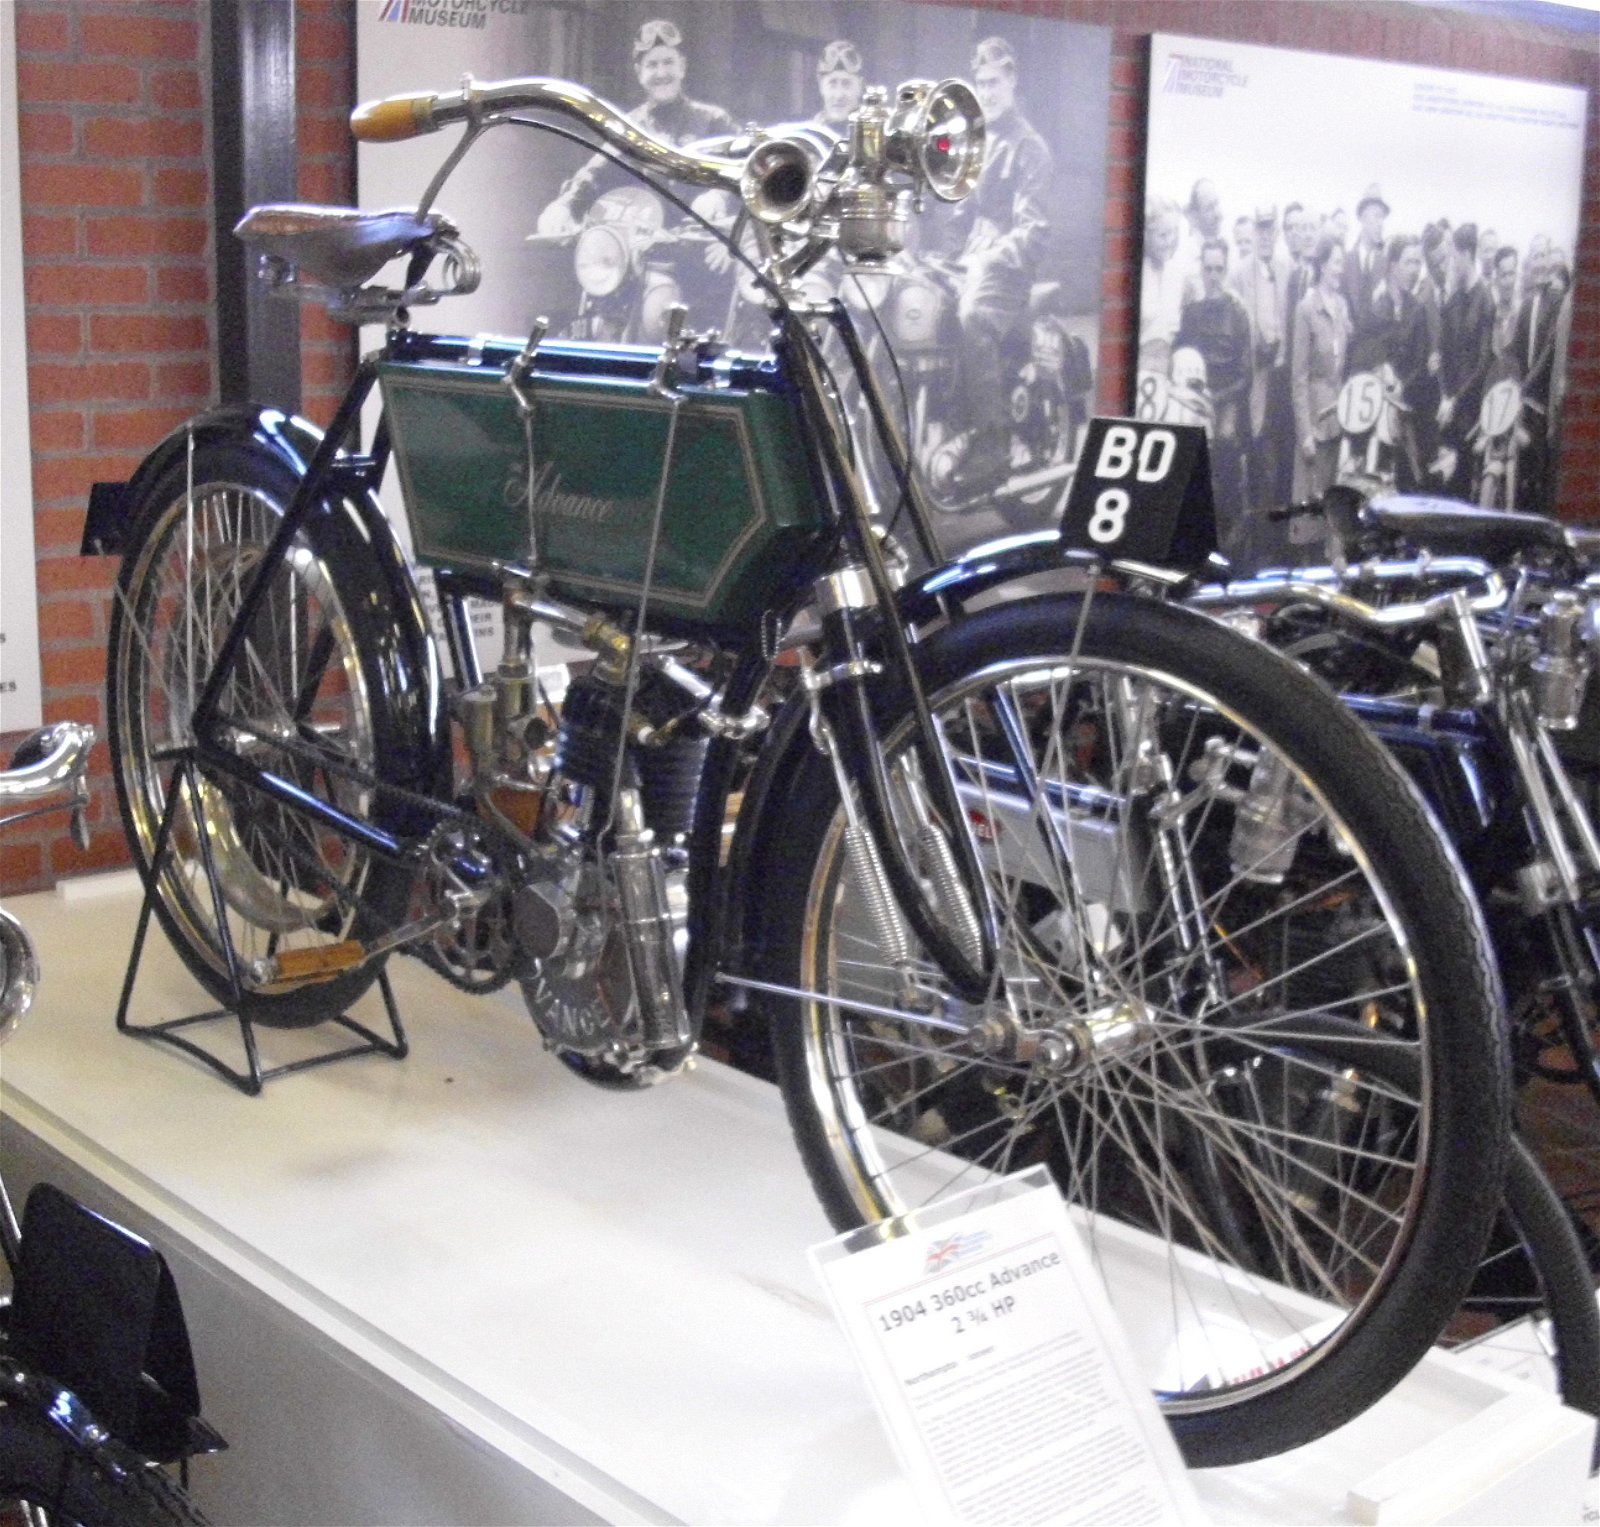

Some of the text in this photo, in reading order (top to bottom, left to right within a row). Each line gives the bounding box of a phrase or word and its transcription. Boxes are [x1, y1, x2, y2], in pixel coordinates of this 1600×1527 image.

[408, 9, 486, 29] MUSEUM
[1345, 381, 1375, 423] 15
[1486, 387, 1512, 426] 17
[1094, 426, 1177, 482] BD
[503, 460, 615, 521] Advance
[1088, 488, 1130, 543] 8
[879, 1252, 1061, 1332] 1904 360cc Advance
[951, 1316, 965, 1334] 2
[992, 1295, 1015, 1318] HP
